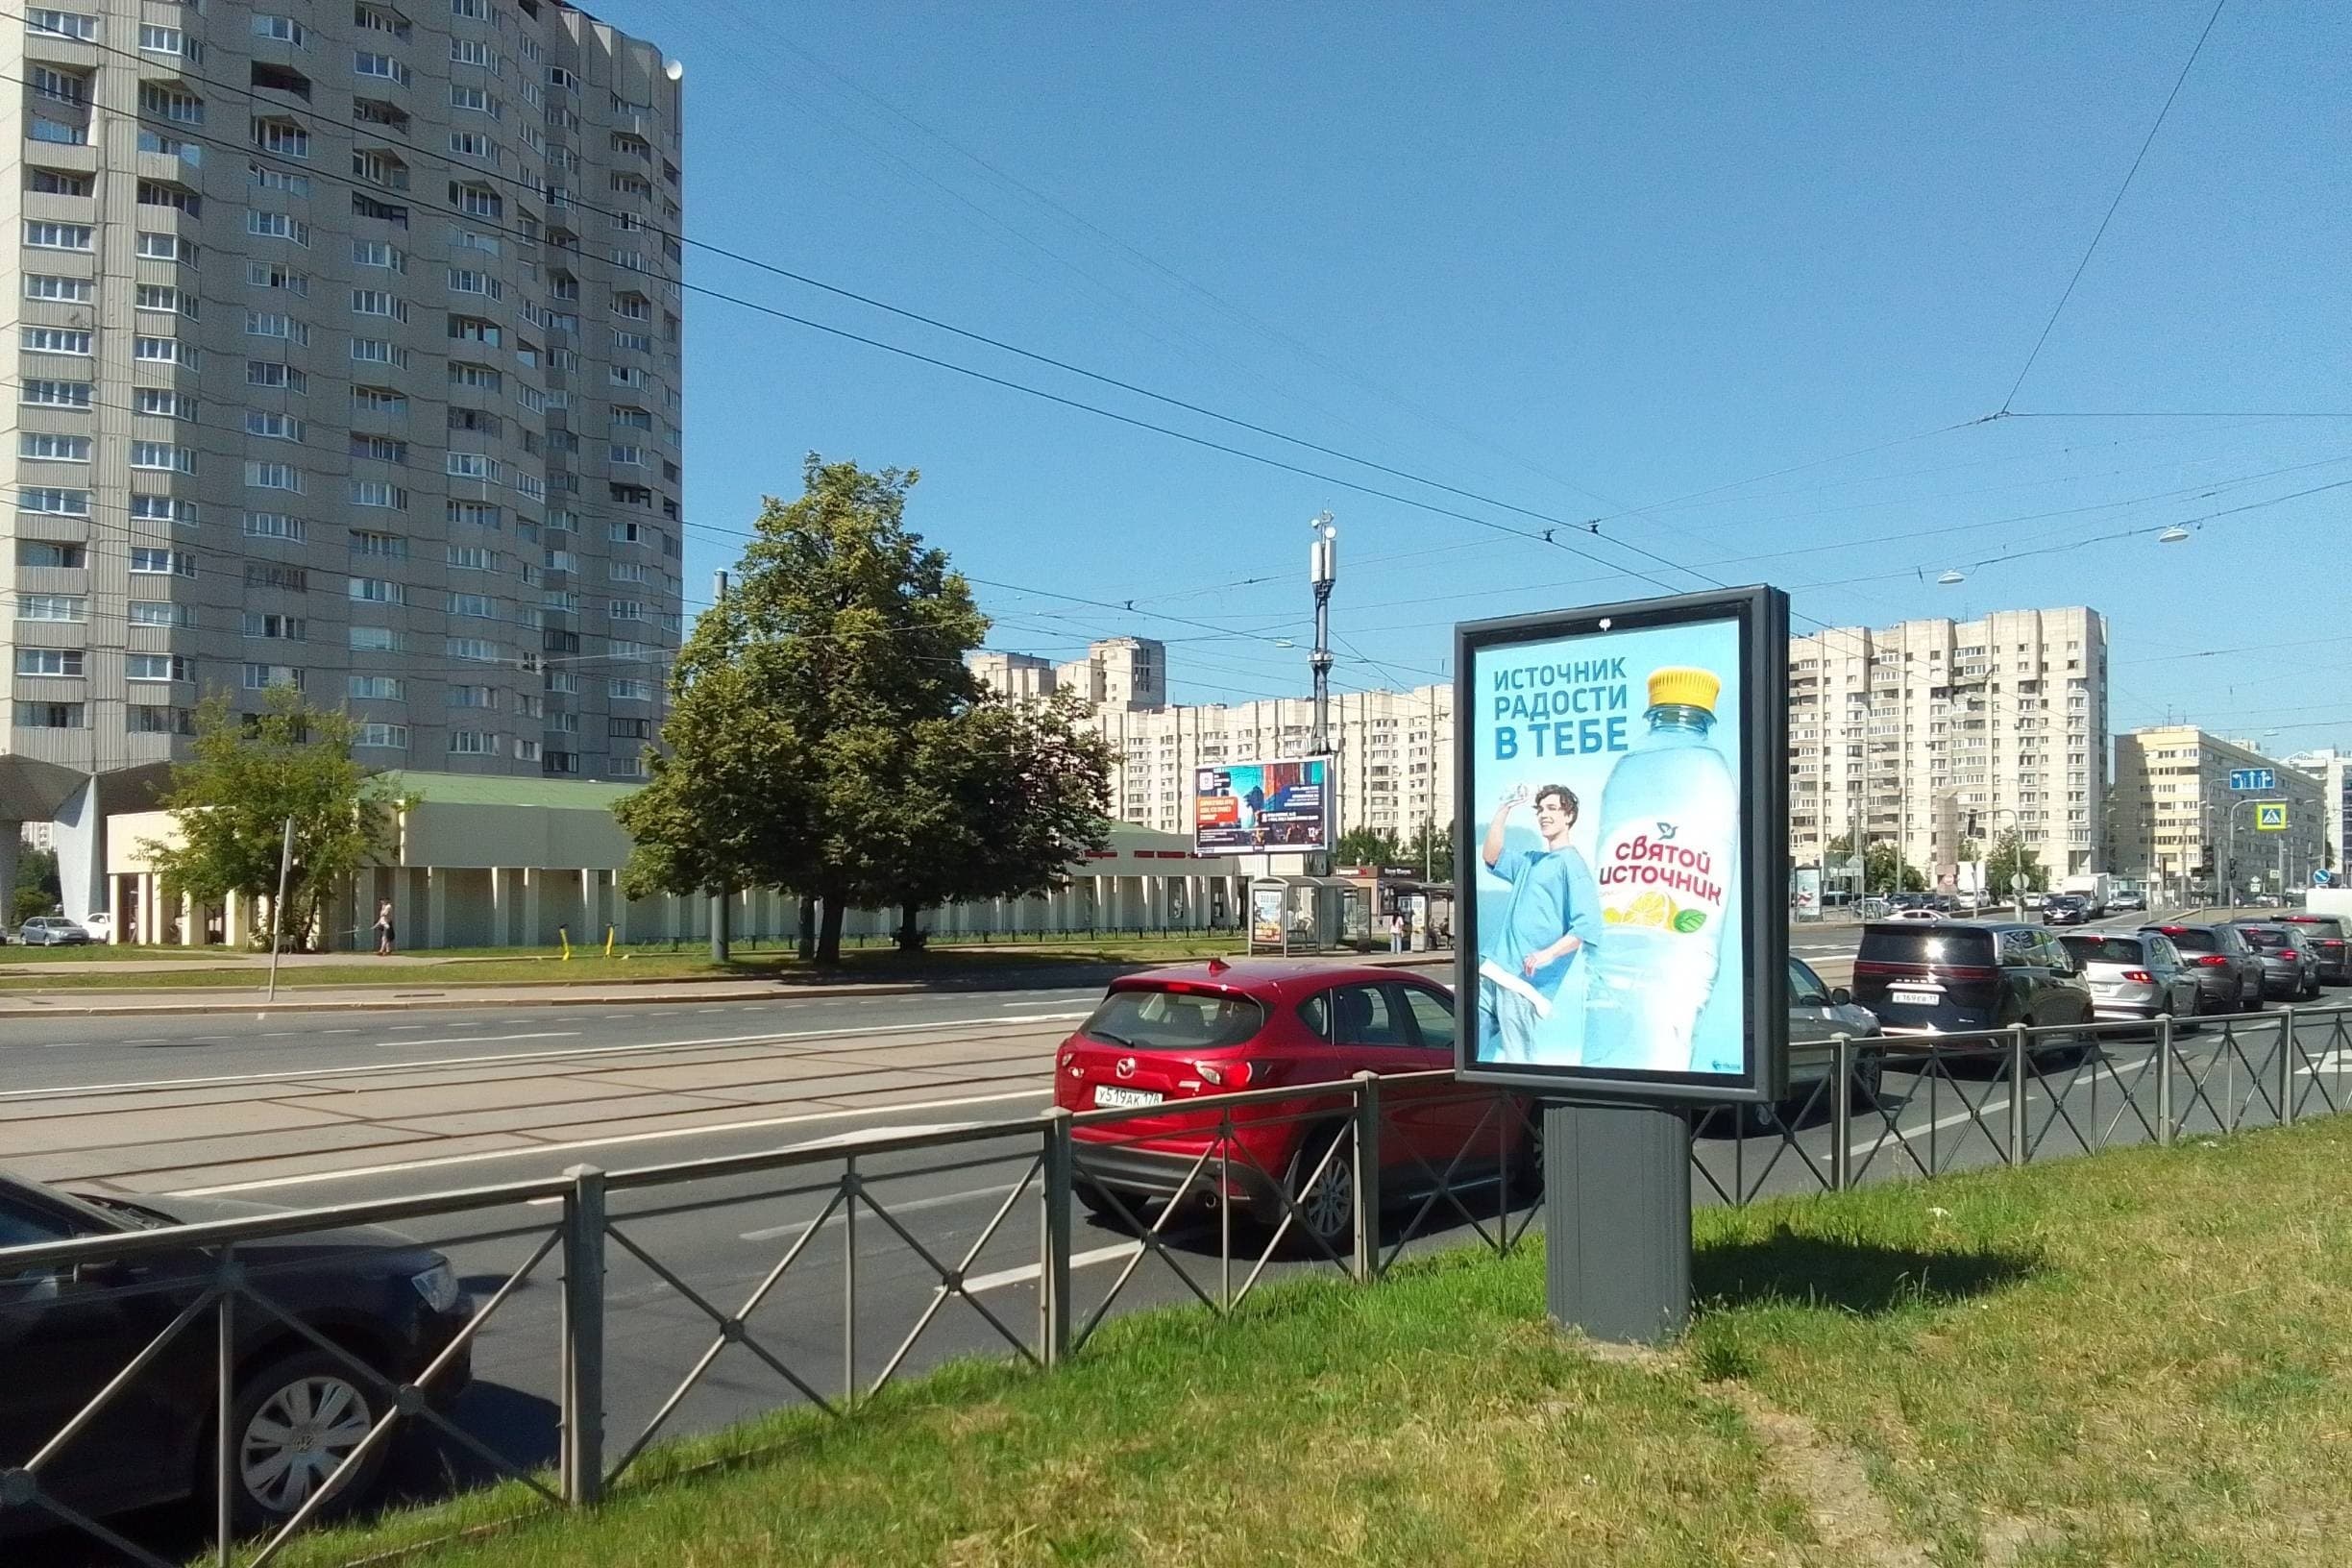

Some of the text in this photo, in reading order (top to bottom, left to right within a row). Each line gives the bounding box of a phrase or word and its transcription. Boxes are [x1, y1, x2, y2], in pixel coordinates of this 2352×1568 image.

[1493, 656, 1628, 692] ИСТОЧНИК
[1494, 684, 1628, 722] РАДОСТИ
[1495, 716, 1629, 761] В ТЕБЕ
